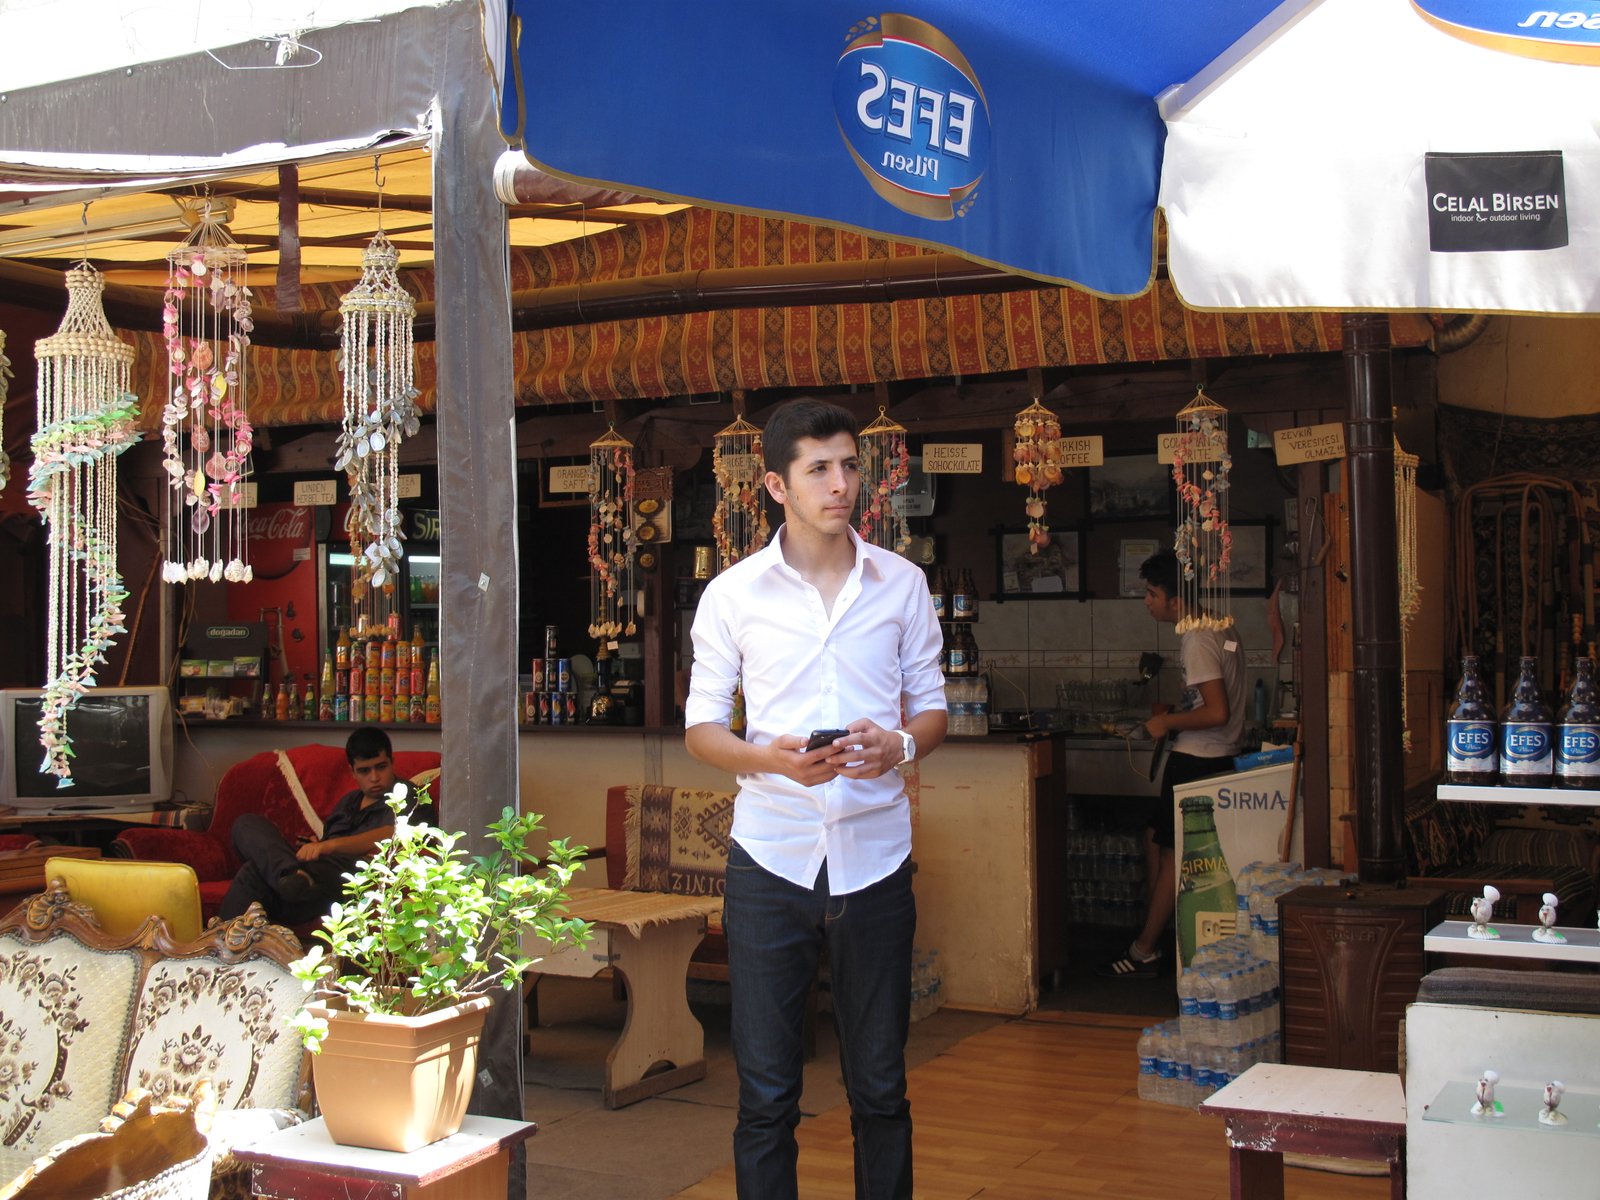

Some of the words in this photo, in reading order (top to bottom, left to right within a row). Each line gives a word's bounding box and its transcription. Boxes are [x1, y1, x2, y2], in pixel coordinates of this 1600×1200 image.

[1432, 192, 1489, 212] CELAL
[1451, 214, 1474, 222] indoor
[1489, 213, 1518, 222] outdoor
[1519, 213, 1541, 222] living
[1058, 439, 1091, 452] RKISH
[933, 447, 968, 458] HEISSE
[562, 479, 586, 490] SAFT
[321, 493, 335, 503] TEA
[1458, 731, 1489, 745] EFES
[1510, 734, 1542, 747] EFES
[1564, 735, 1596, 749] EFES
[1217, 788, 1289, 811] SIRMA
[1181, 855, 1228, 877] SIRMA
